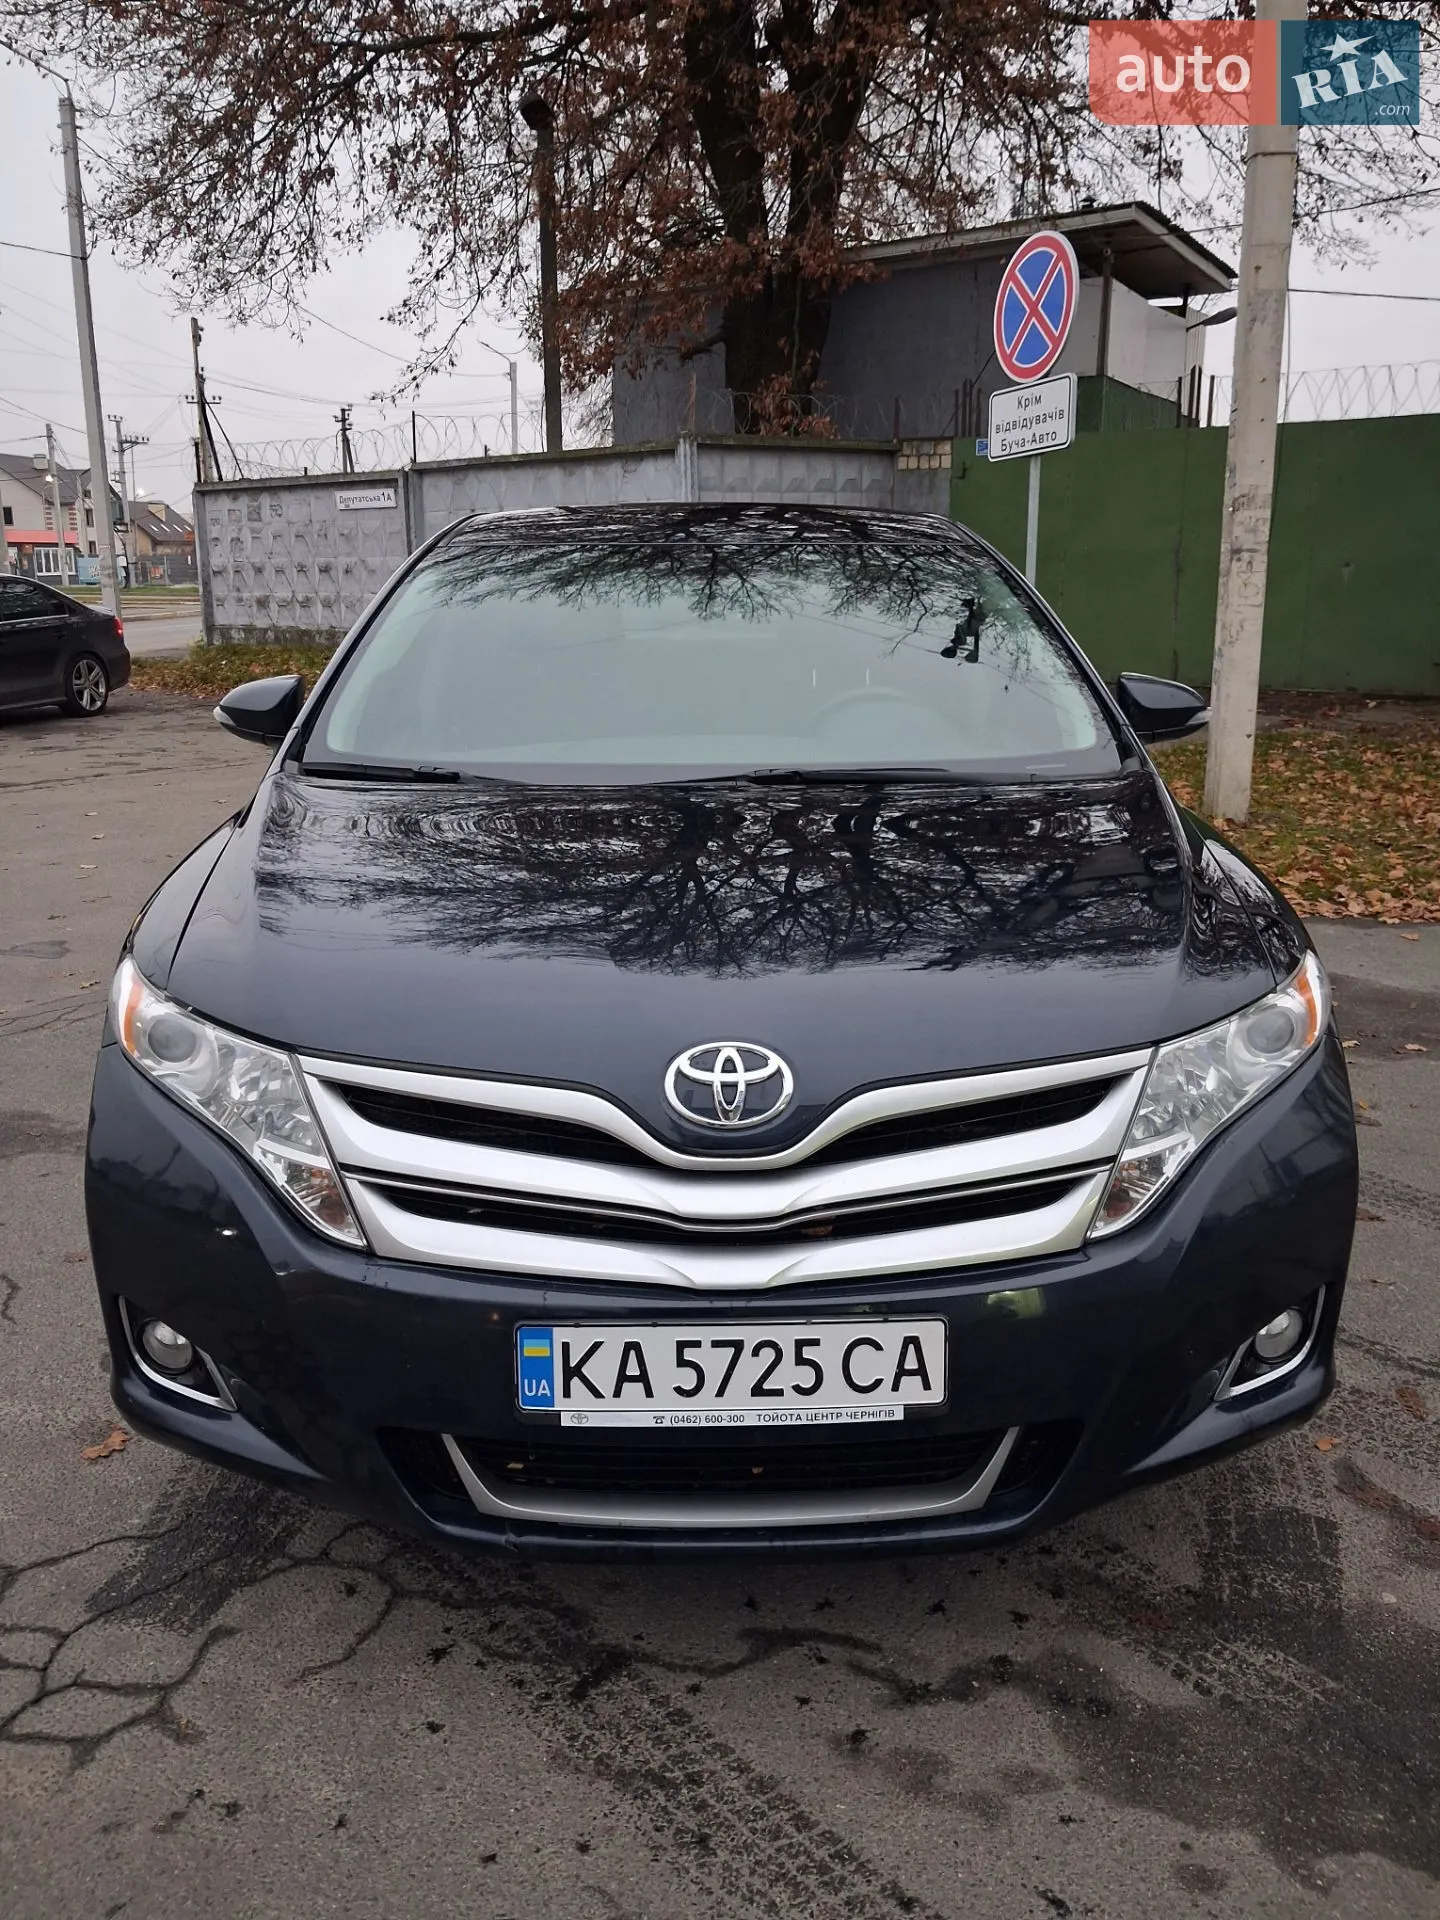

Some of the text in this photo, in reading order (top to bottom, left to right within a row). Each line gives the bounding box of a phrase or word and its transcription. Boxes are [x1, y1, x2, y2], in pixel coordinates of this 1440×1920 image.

[1017, 393, 1042, 411] Крім
[995, 407, 1064, 434] відвідувачів
[1000, 431, 1057, 454] Буча-Авто
[672, 1337, 824, 1398] 5725
[523, 1379, 551, 1398] UA
[670, 1409, 895, 1426] (0462) 600-300 ТОЙОТА ЦЕНТР ЧЕРНІГІВ
